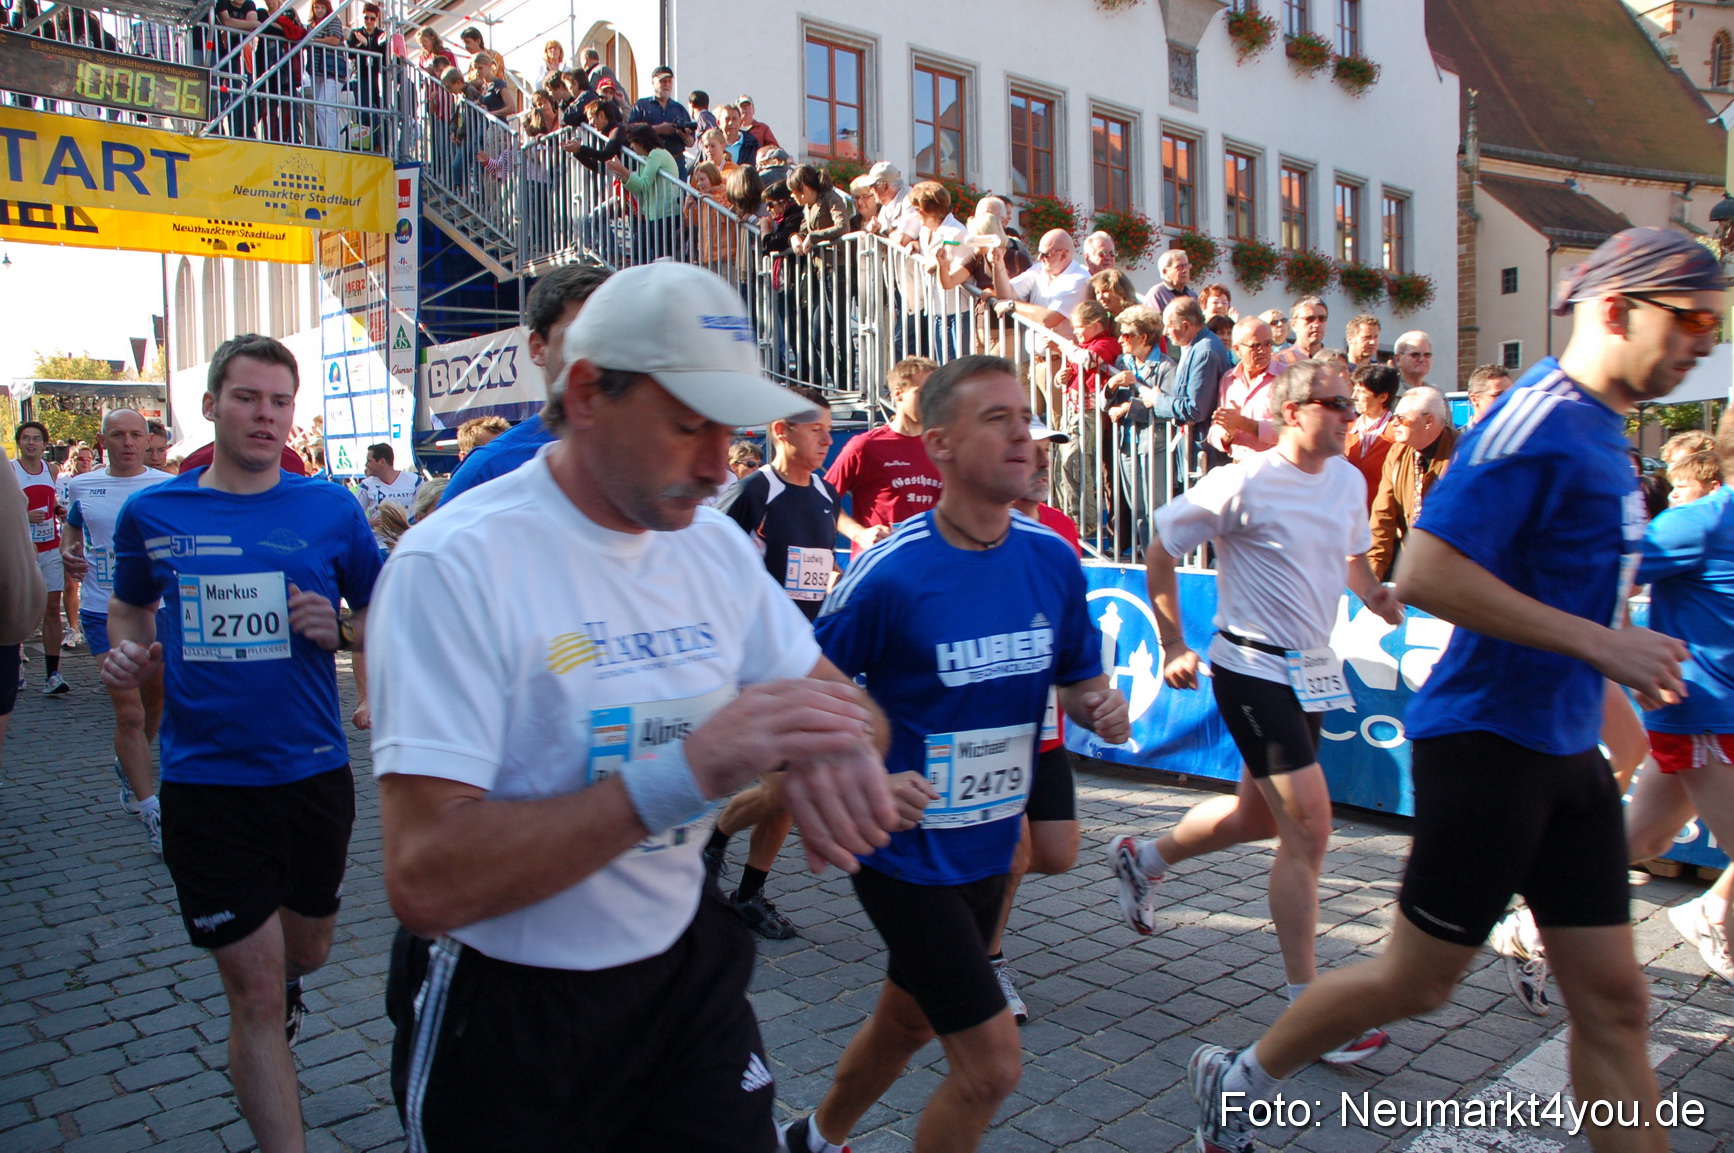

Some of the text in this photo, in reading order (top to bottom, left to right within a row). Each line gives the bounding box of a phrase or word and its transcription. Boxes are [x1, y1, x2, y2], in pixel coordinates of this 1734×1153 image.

[30, 40, 94, 61] Elektronische
[232, 184, 363, 207] Neumarkter Stadtlauf
[171, 222, 287, 241] Neumarkter Stadtlauf
[891, 474, 944, 489] Gasthaus
[803, 553, 824, 566] Ludwig
[803, 571, 829, 586] 2852
[205, 583, 258, 600] Markus
[185, 608, 192, 621] A
[210, 611, 280, 637] 2700
[935, 628, 1054, 672] HUBER
[1307, 675, 1342, 694] 3275
[959, 766, 1023, 801] 2479
